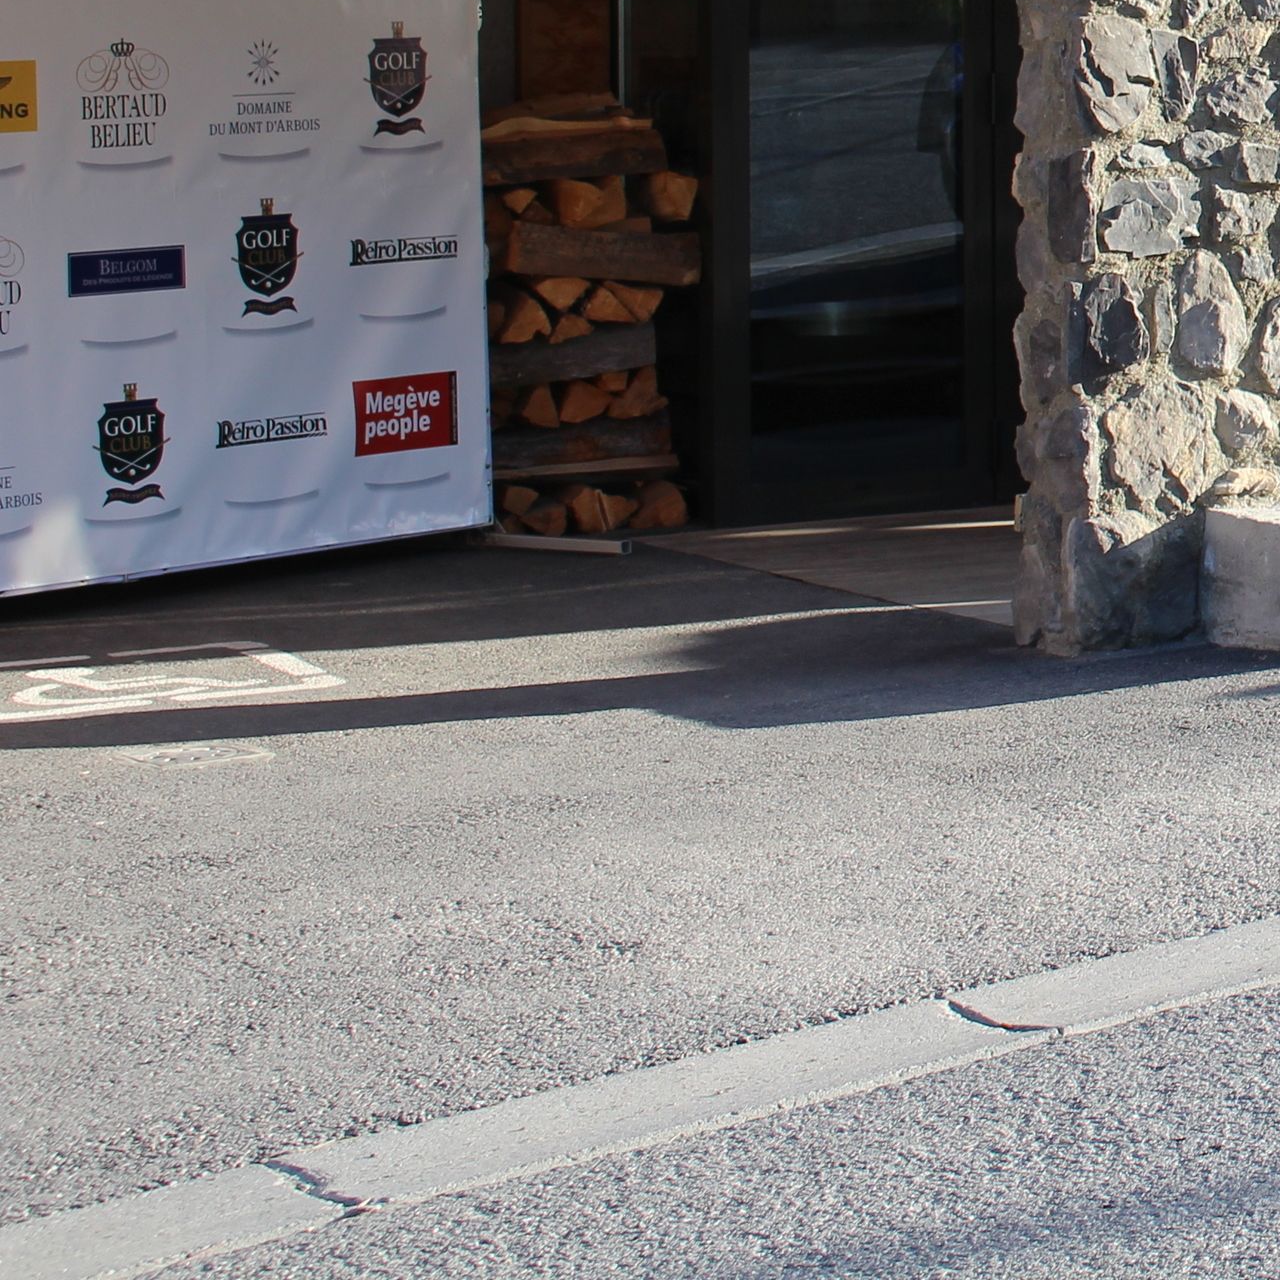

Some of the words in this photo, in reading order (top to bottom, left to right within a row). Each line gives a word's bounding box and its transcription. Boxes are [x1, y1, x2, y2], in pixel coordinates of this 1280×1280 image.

[374, 52, 420, 71] GOLF
[380, 70, 416, 86] CLUB
[81, 93, 167, 120] BERTAUD
[237, 100, 292, 115] DOMAINE
[90, 122, 156, 149] BELIEU
[209, 123, 226, 136] DU
[243, 228, 291, 249] GOLF
[100, 258, 158, 275] BELGOM
[249, 247, 286, 266] CLUB
[365, 386, 441, 415] Megève
[105, 414, 156, 437] GOLF
[364, 410, 431, 443] people
[110, 434, 151, 454] CLUB
